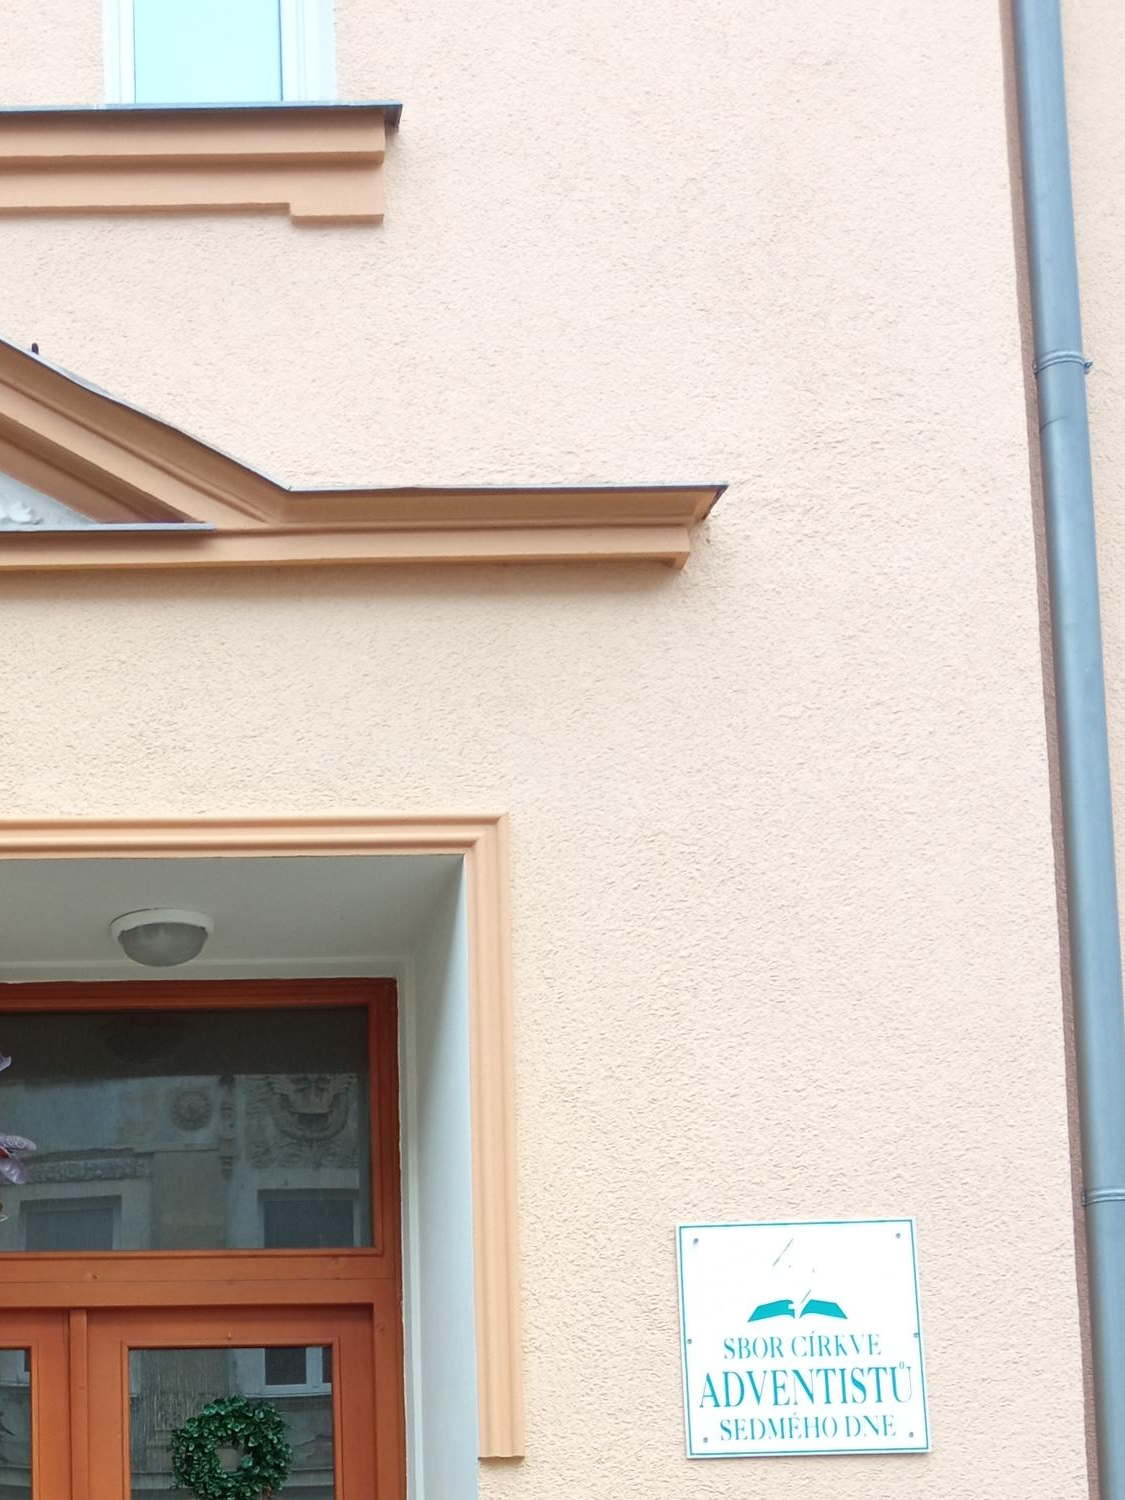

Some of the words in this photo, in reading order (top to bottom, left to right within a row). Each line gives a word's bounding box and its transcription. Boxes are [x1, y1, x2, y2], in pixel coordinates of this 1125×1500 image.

[723, 1336, 785, 1360] SBOR
[791, 1330, 882, 1358] CÍRKVE
[699, 1361, 913, 1409] ADVENTISTŮ
[719, 1412, 838, 1441] SEDMÉHO
[845, 1414, 897, 1438] DNE
